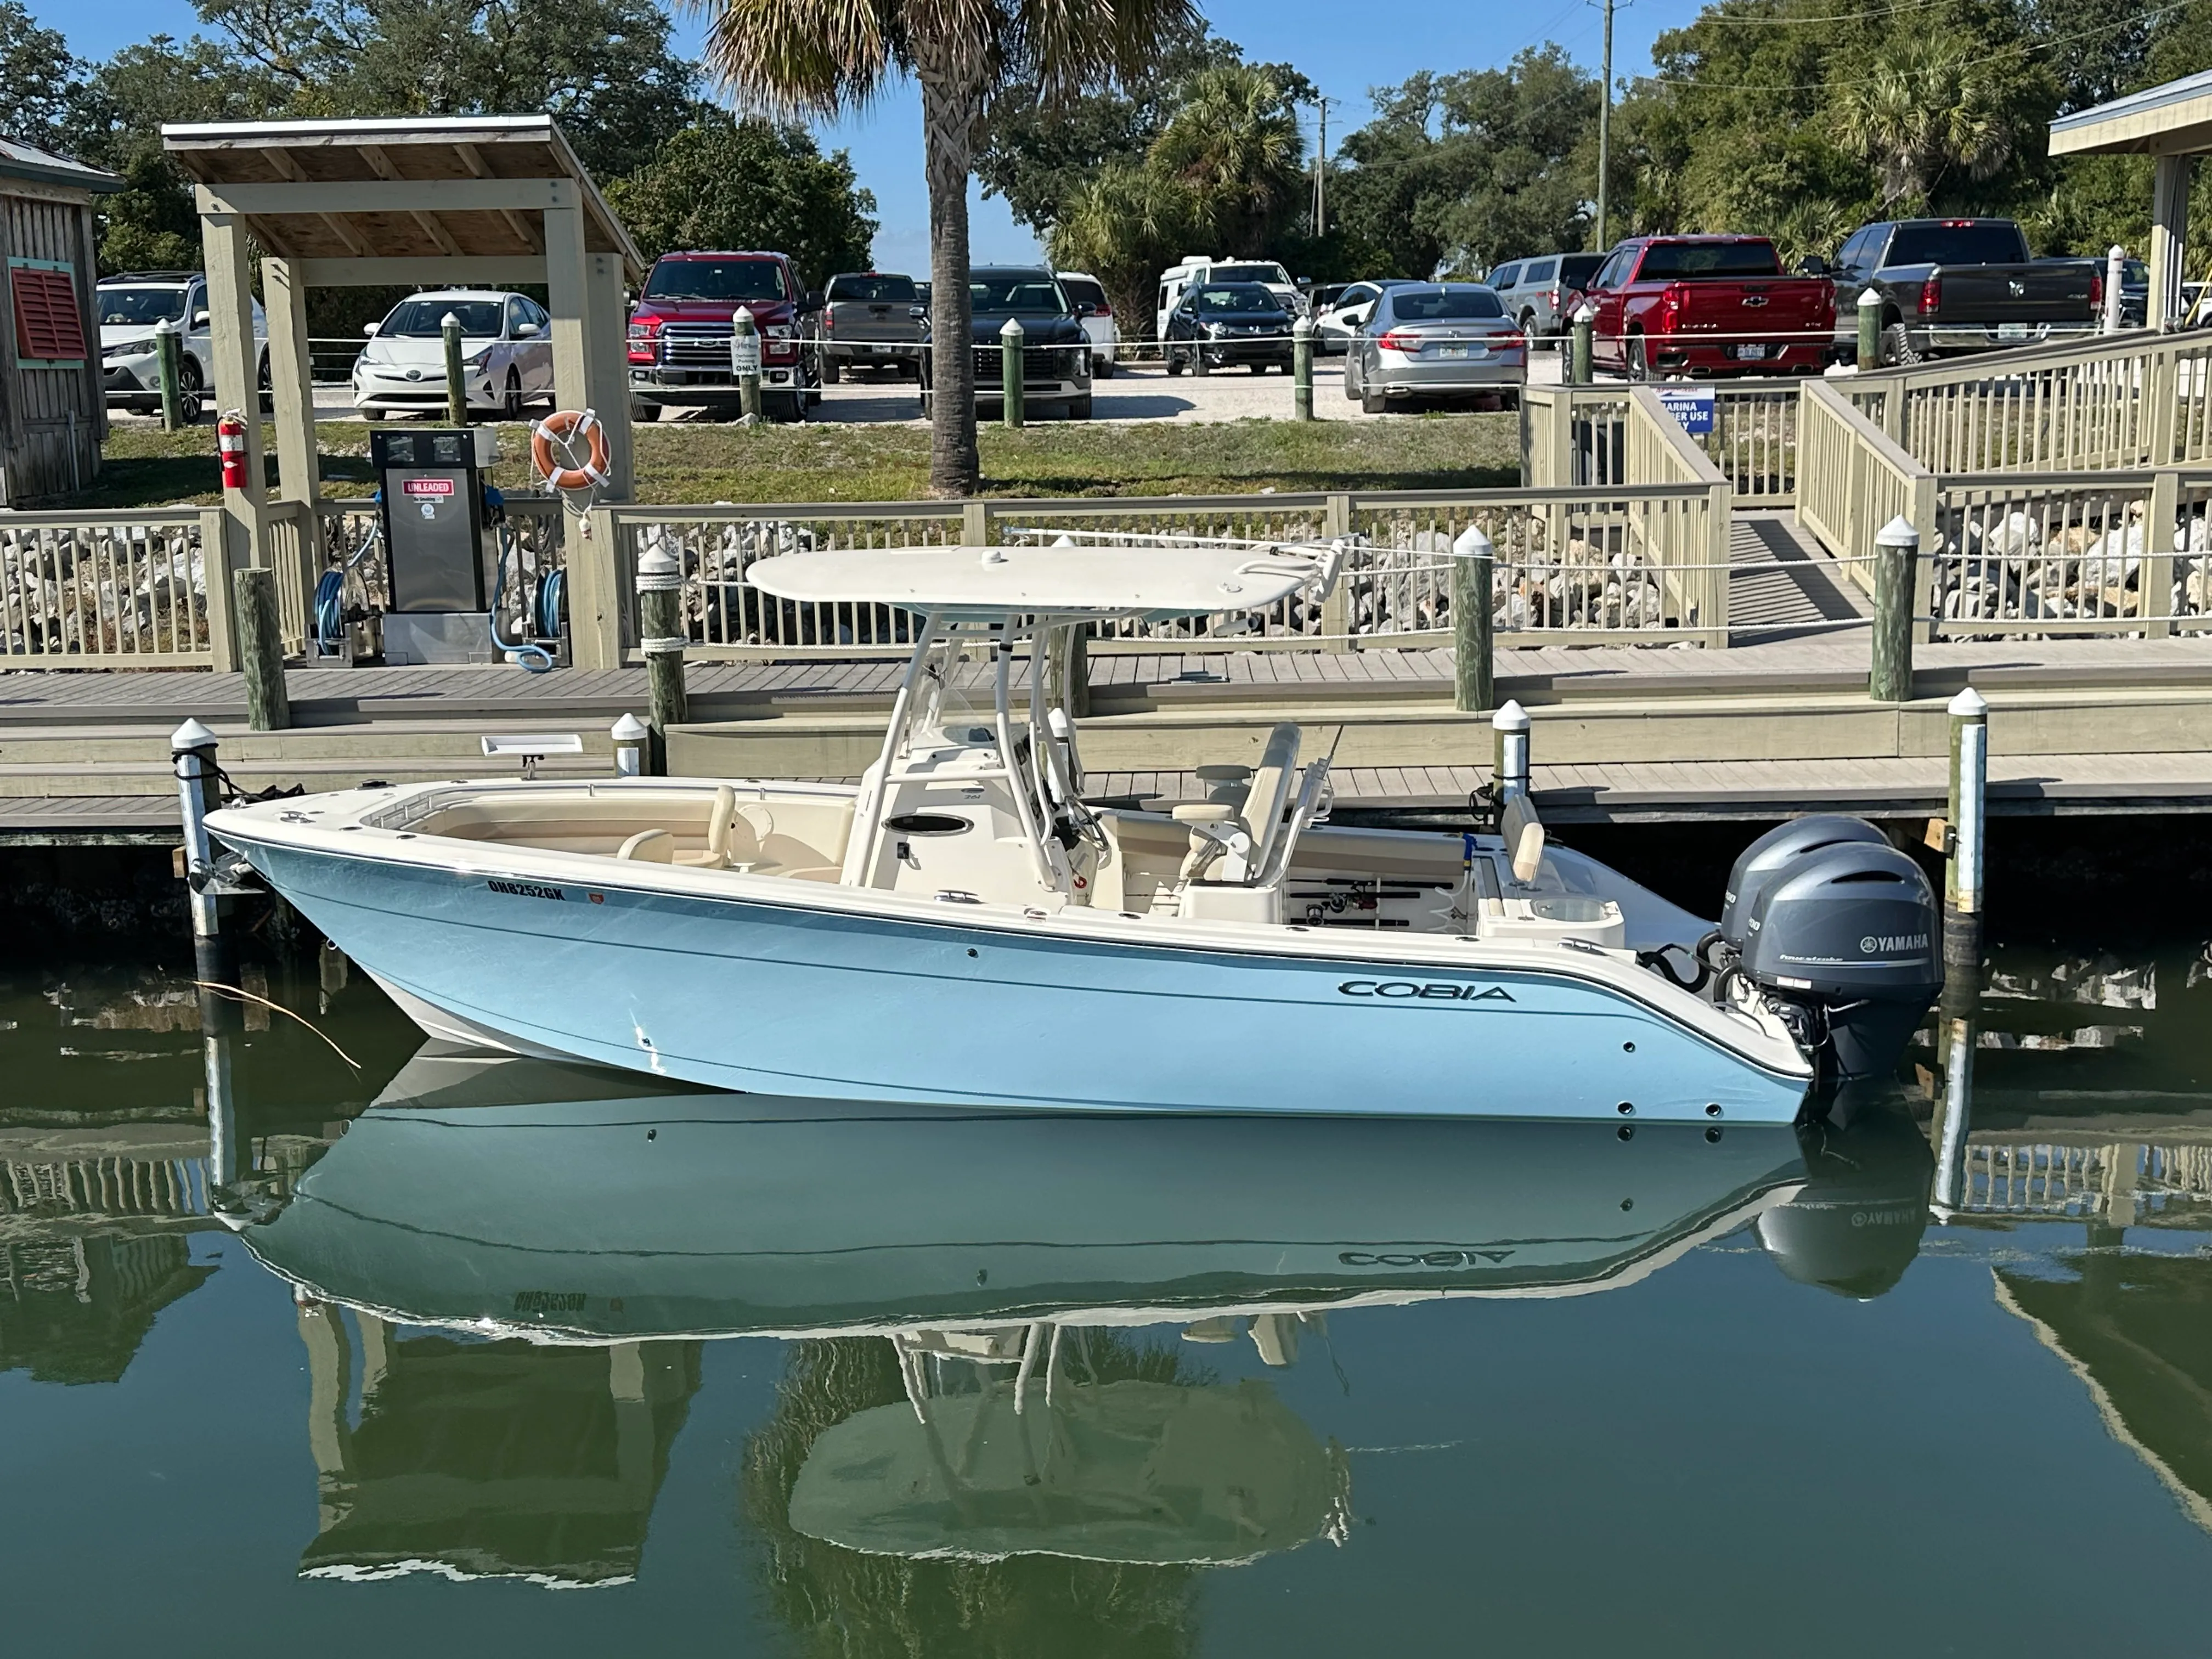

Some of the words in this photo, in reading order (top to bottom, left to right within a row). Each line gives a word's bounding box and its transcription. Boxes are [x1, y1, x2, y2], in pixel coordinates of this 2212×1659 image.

[1690, 411, 1708, 421] USE
[408, 483, 449, 492] UNLEADED
[487, 881, 567, 901] OH8252GK
[1878, 933, 1928, 952] YAMAHA
[1338, 981, 1517, 1002] COBIA
